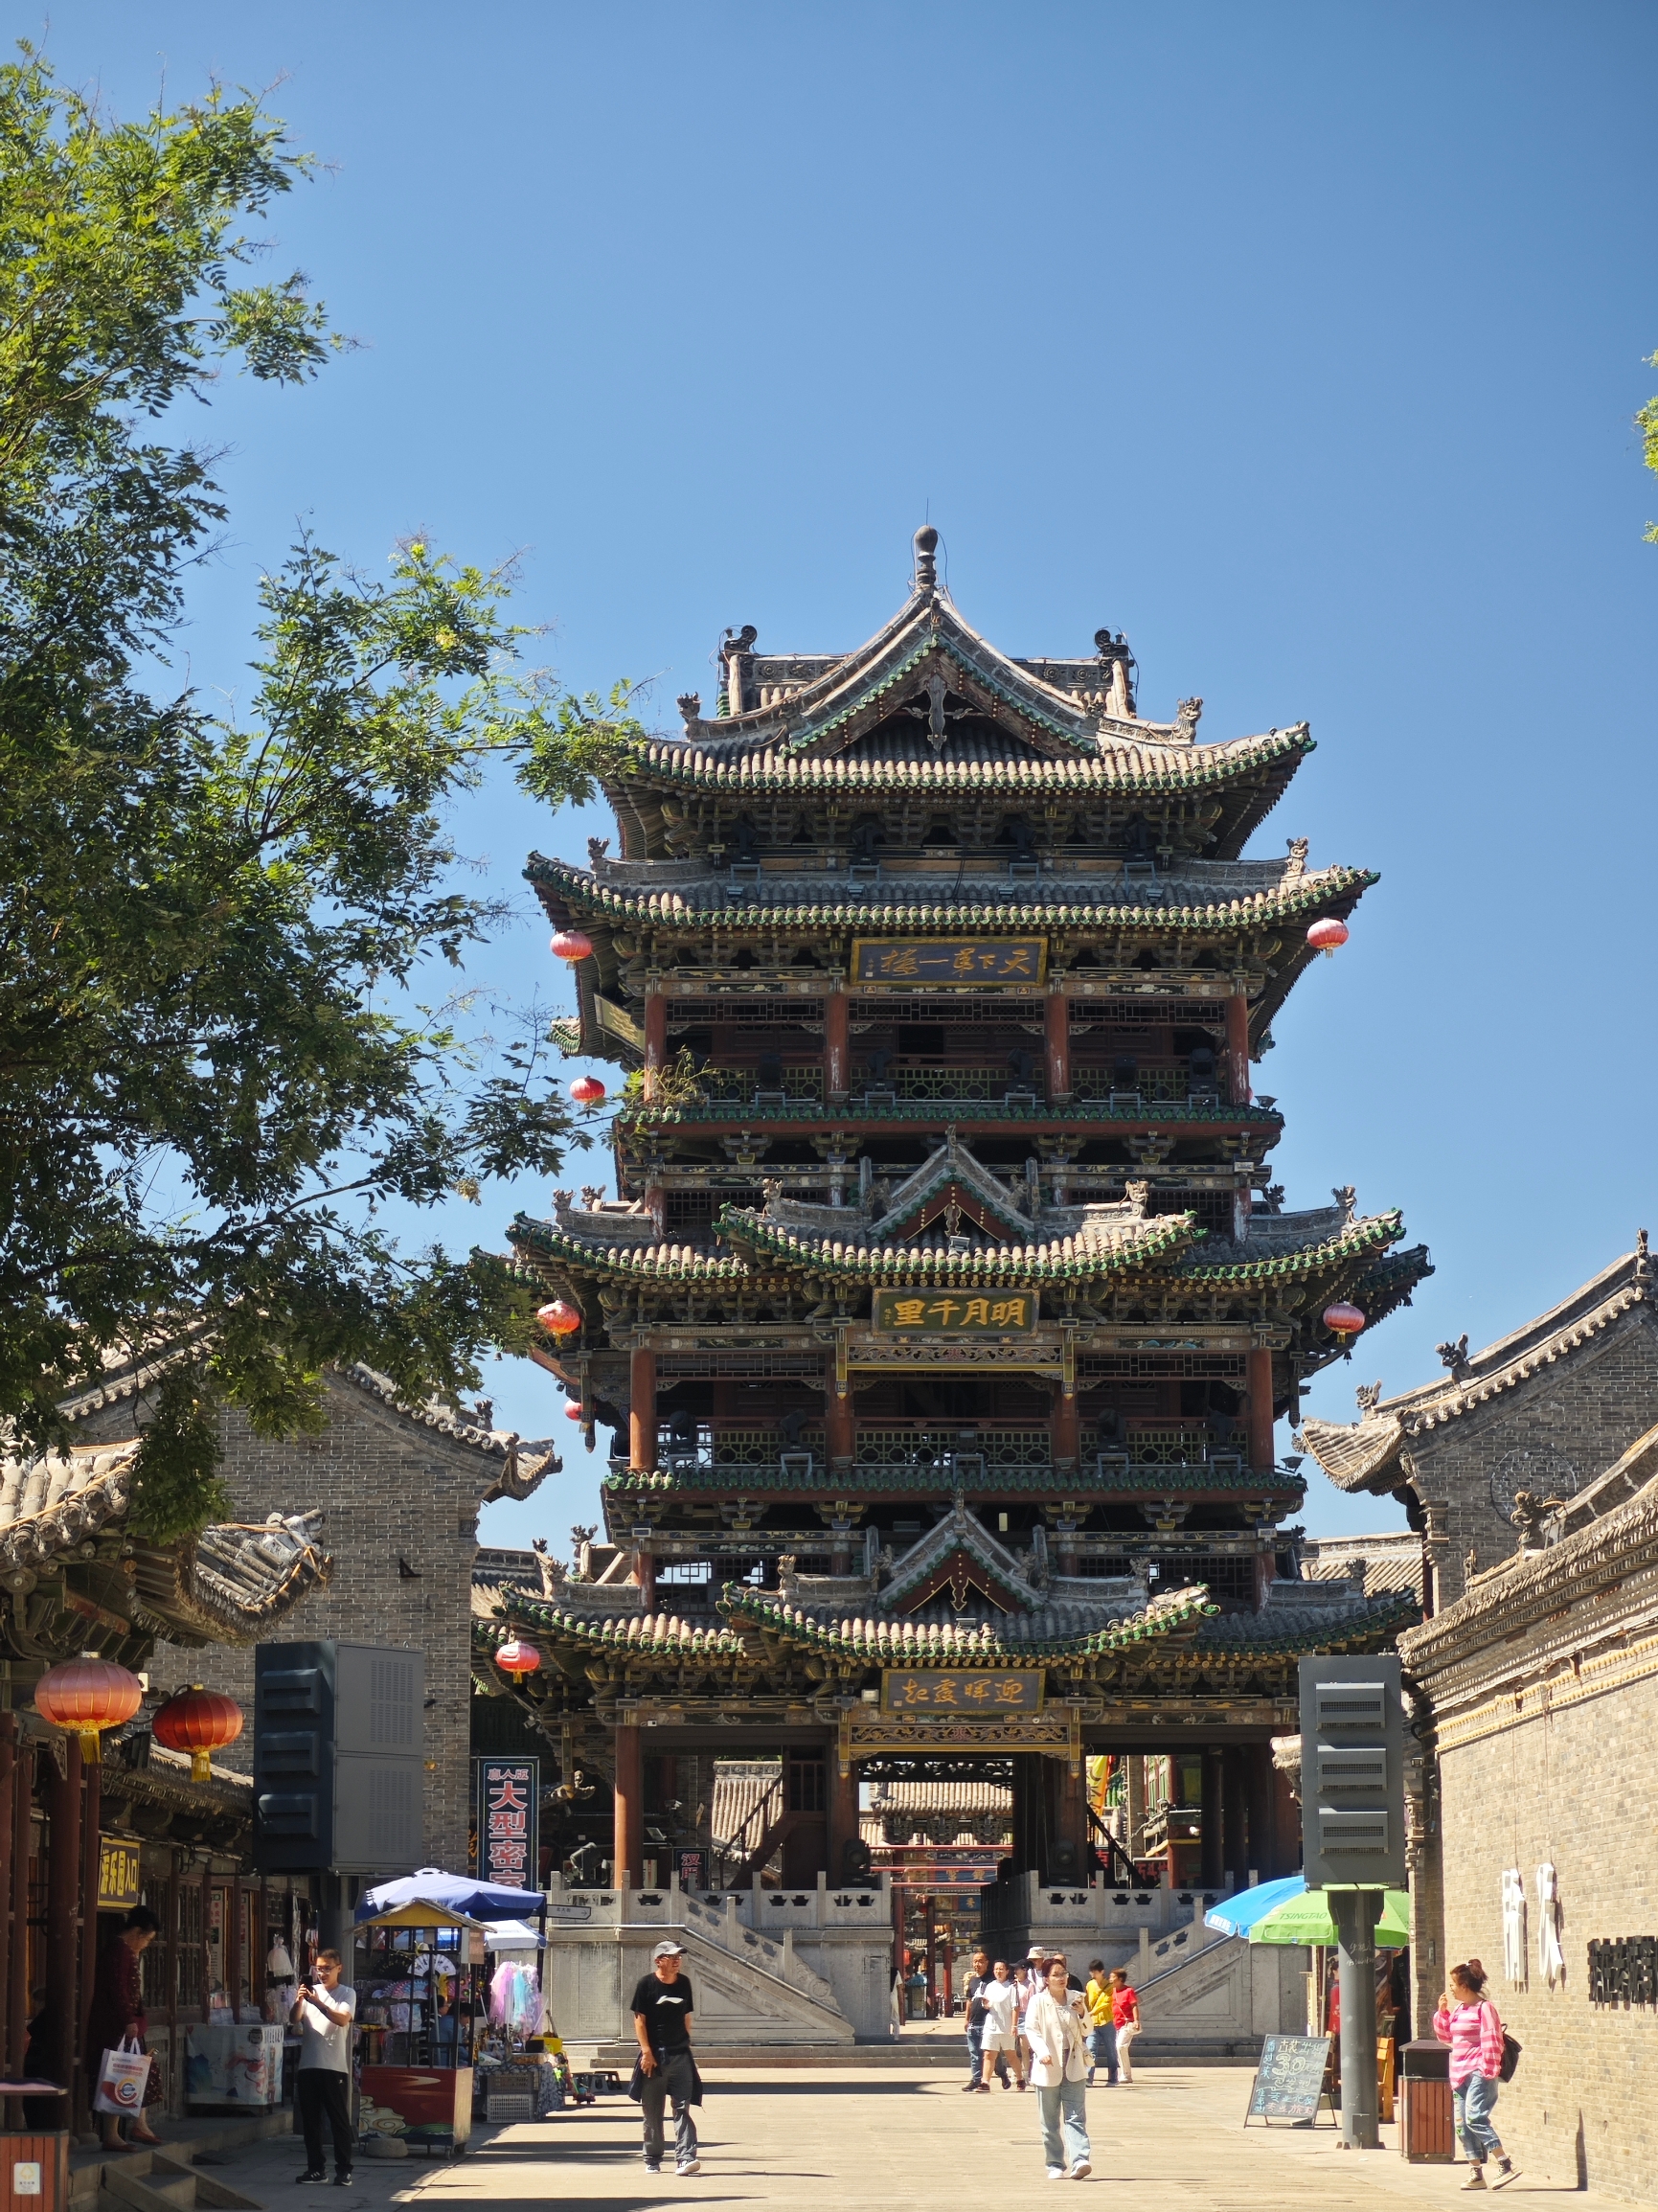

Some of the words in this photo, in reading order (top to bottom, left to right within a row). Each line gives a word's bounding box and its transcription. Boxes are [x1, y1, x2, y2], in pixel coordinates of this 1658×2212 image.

[893, 1297, 1026, 1327] 明月千里
[488, 1768, 530, 1781] 真人版
[1279, 1912, 1328, 1921] TSINGTAO
